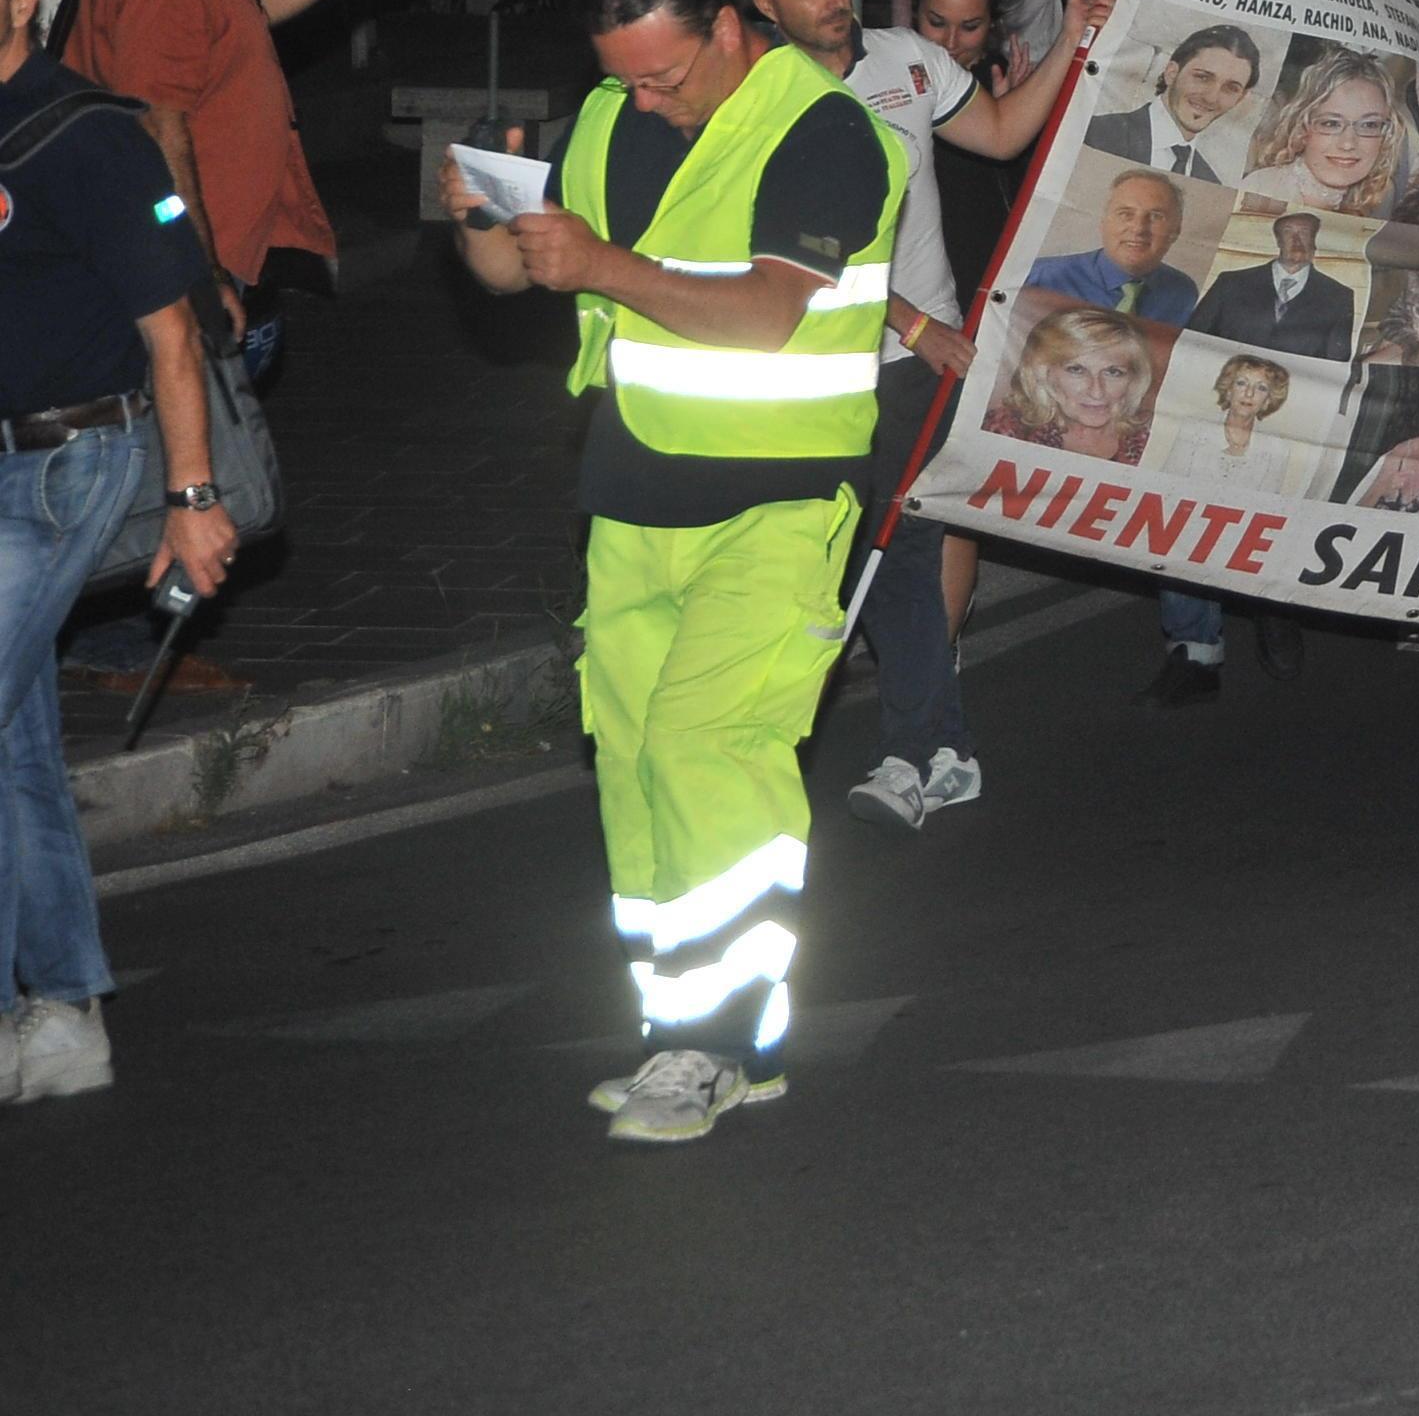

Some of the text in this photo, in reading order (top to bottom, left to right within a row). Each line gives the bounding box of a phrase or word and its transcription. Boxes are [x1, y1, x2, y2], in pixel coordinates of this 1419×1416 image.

[1303, 8, 1357, 37] RACHID,
[1362, 20, 1393, 45] ANA,
[967, 460, 1288, 574] NIENTE
